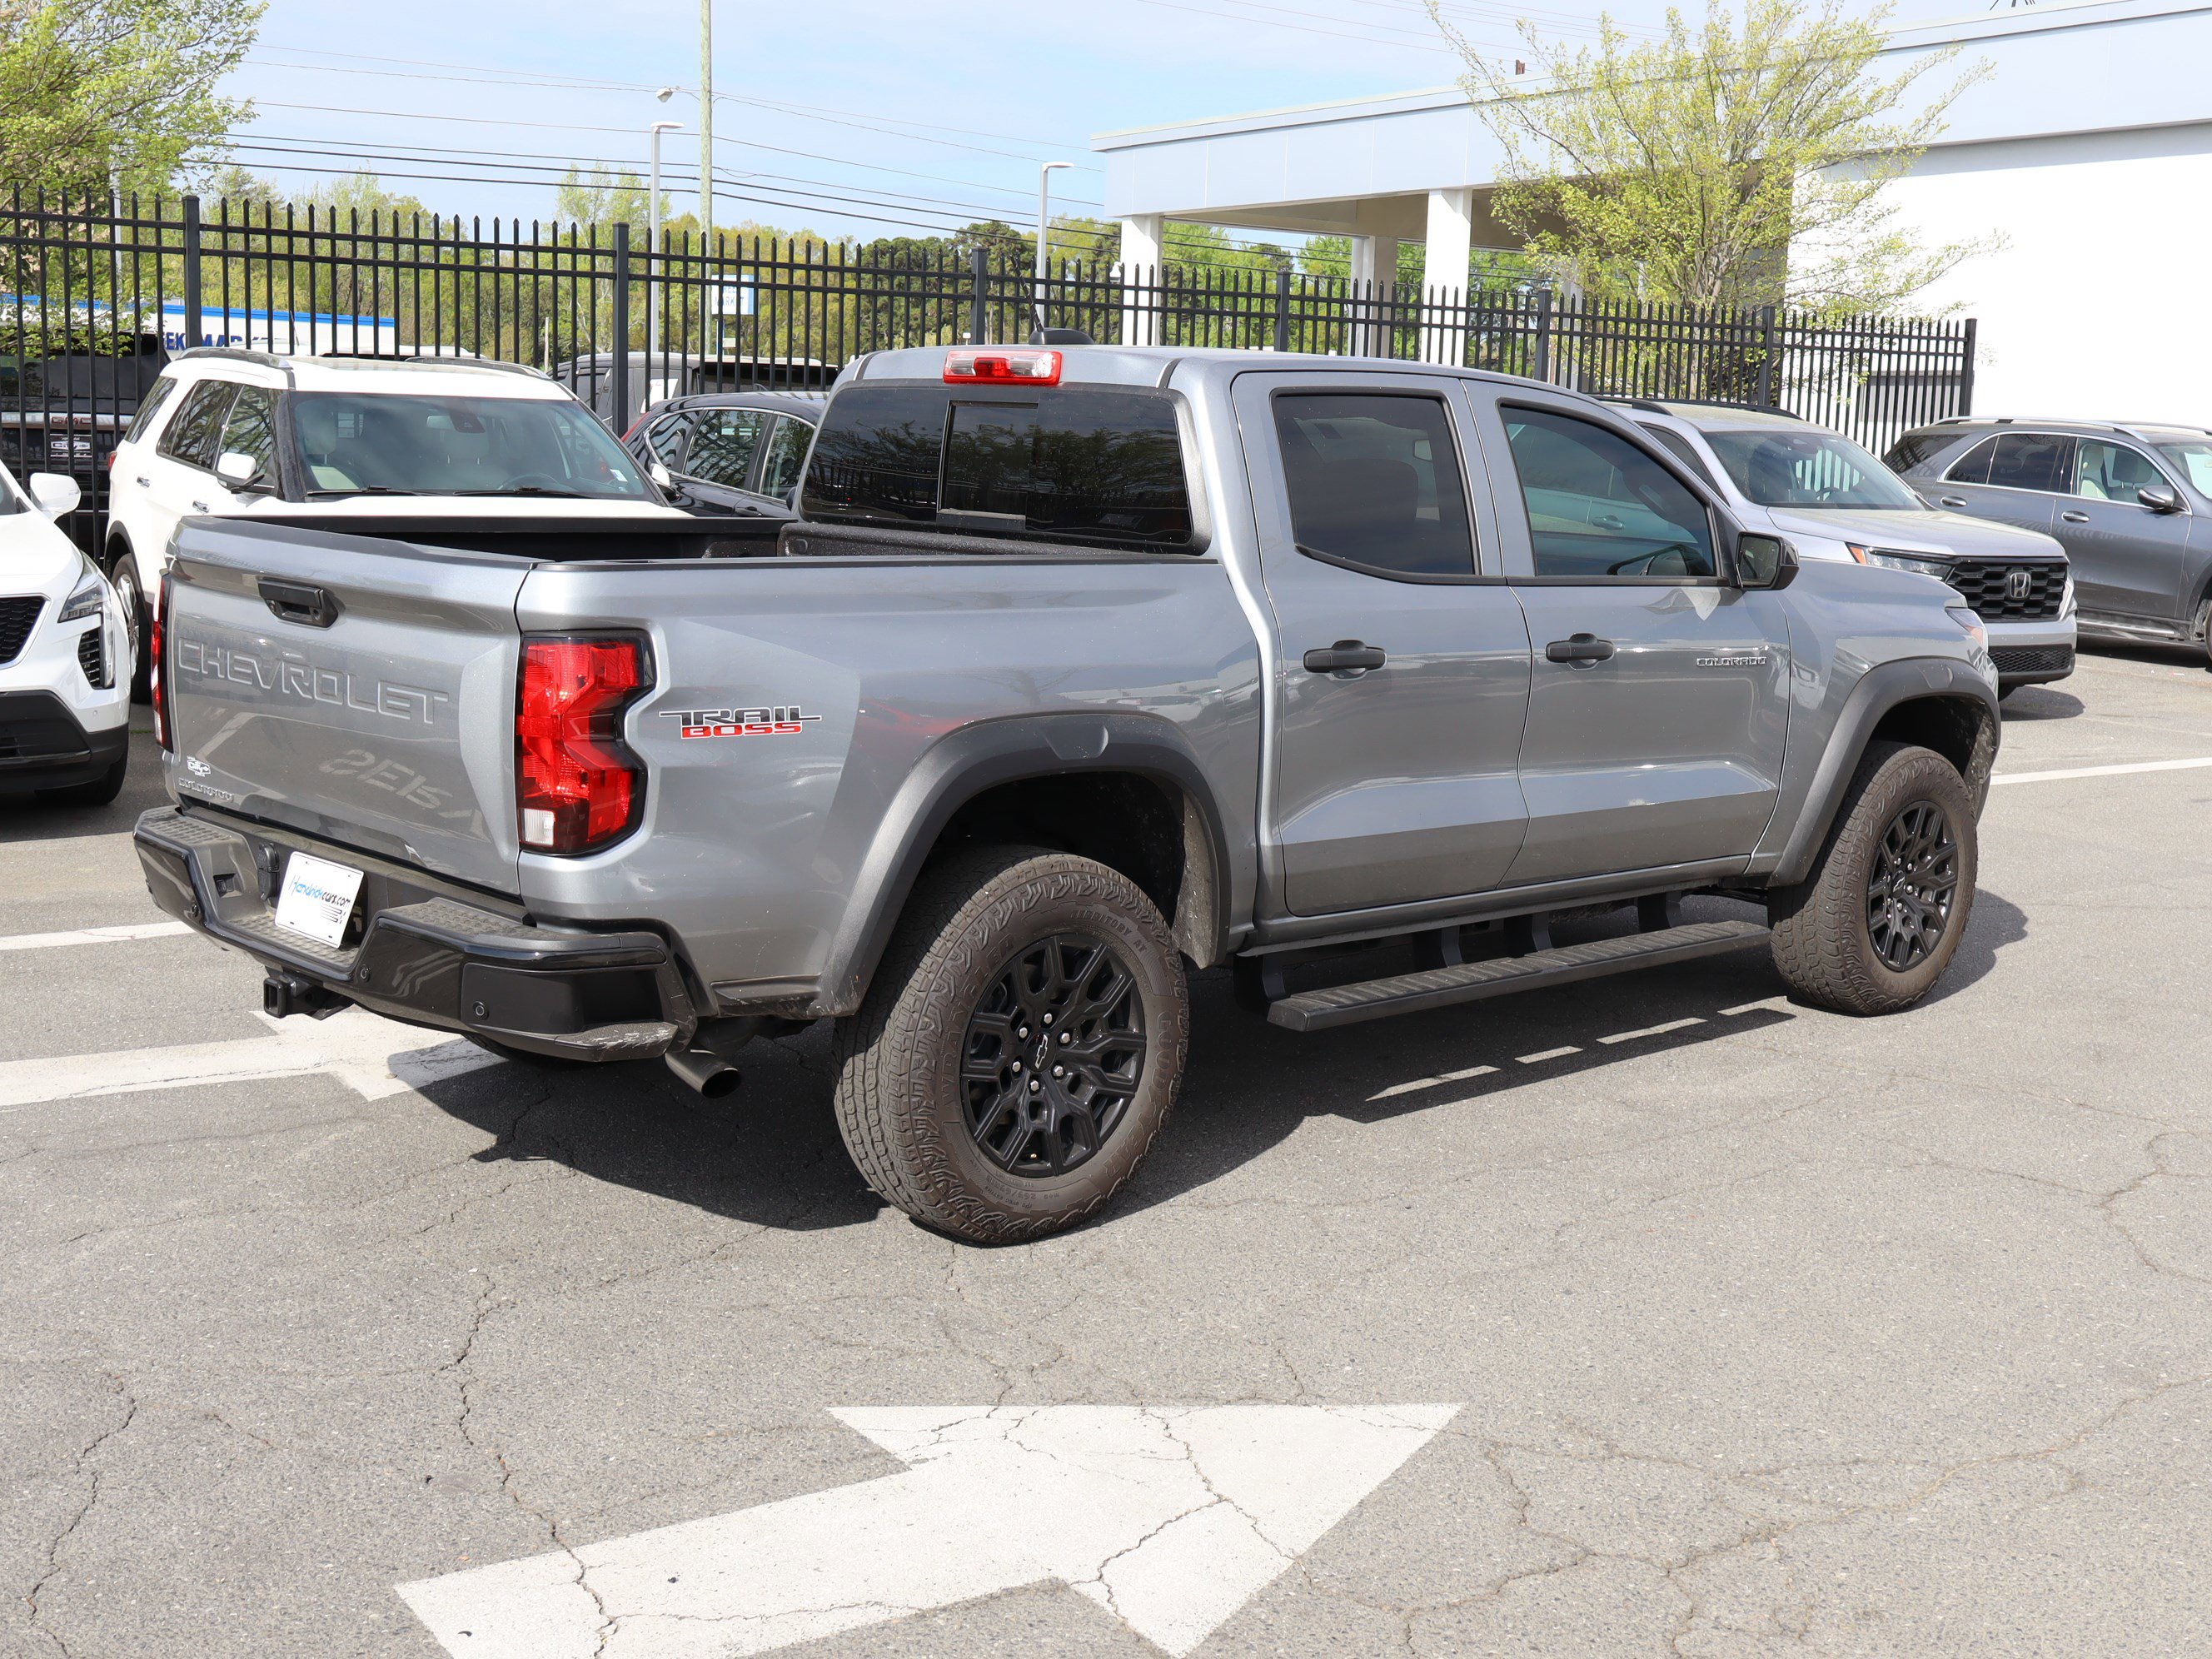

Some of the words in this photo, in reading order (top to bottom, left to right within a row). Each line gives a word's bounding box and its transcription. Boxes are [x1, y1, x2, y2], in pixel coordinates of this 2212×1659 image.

[1696, 656, 1767, 667] COLORADO
[179, 637, 449, 725] CHEVROLET
[659, 705, 822, 727] TRAIL
[680, 720, 802, 739] BOSS
